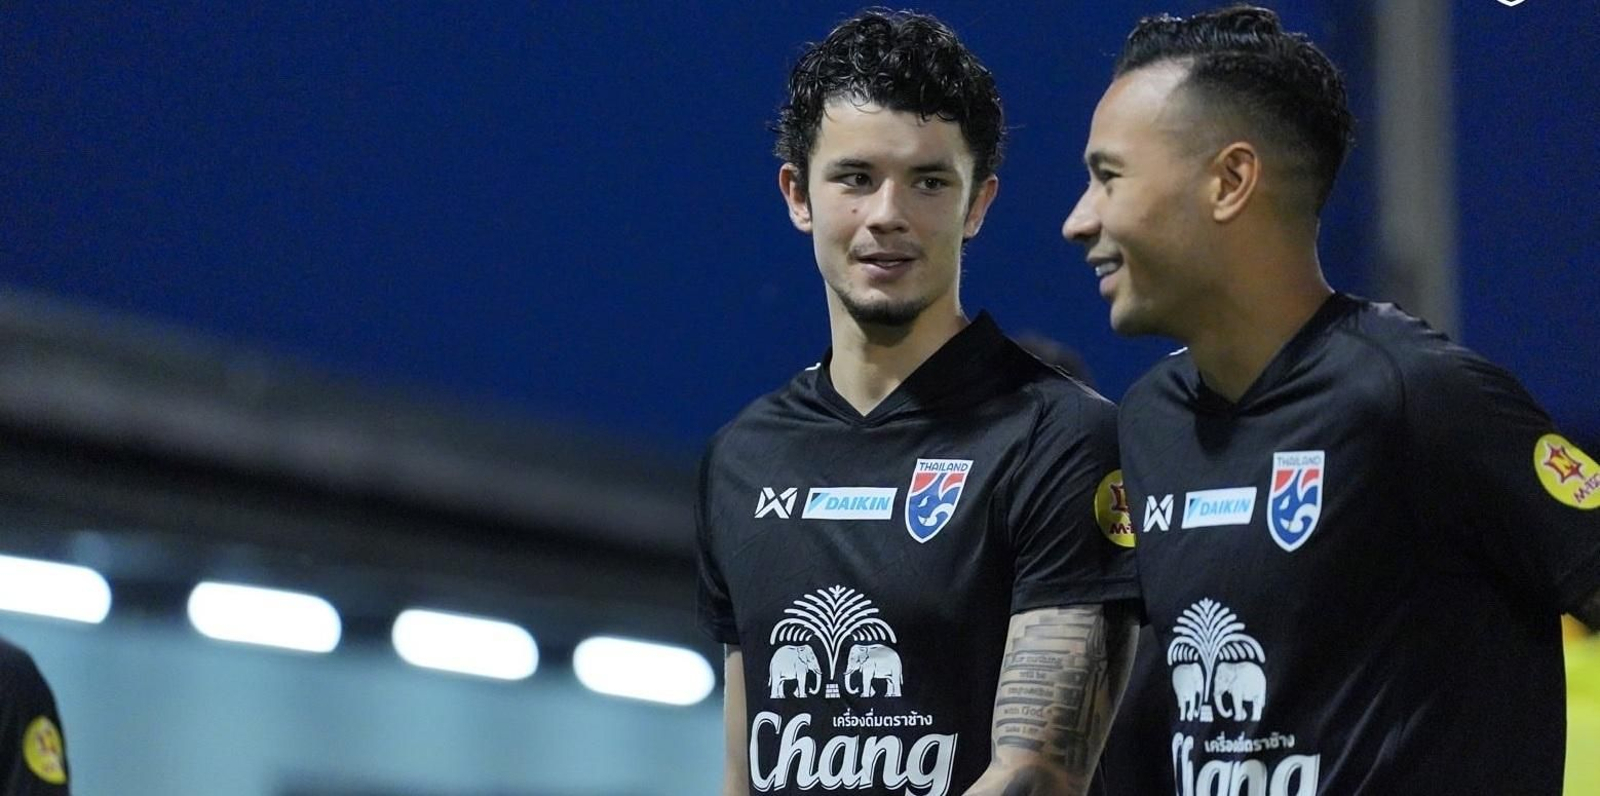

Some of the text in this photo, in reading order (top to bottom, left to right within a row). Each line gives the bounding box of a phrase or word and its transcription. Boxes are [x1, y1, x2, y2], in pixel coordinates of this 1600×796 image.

[919, 461, 969, 472] THAILAND
[1277, 456, 1321, 466] THAILAND
[825, 496, 890, 511] DAIKIN
[1199, 497, 1251, 516] DAIKIN
[833, 708, 933, 727] เครื่องดื่มตราช้าง
[1022, 706, 1043, 717] God
[749, 711, 958, 796] Chang
